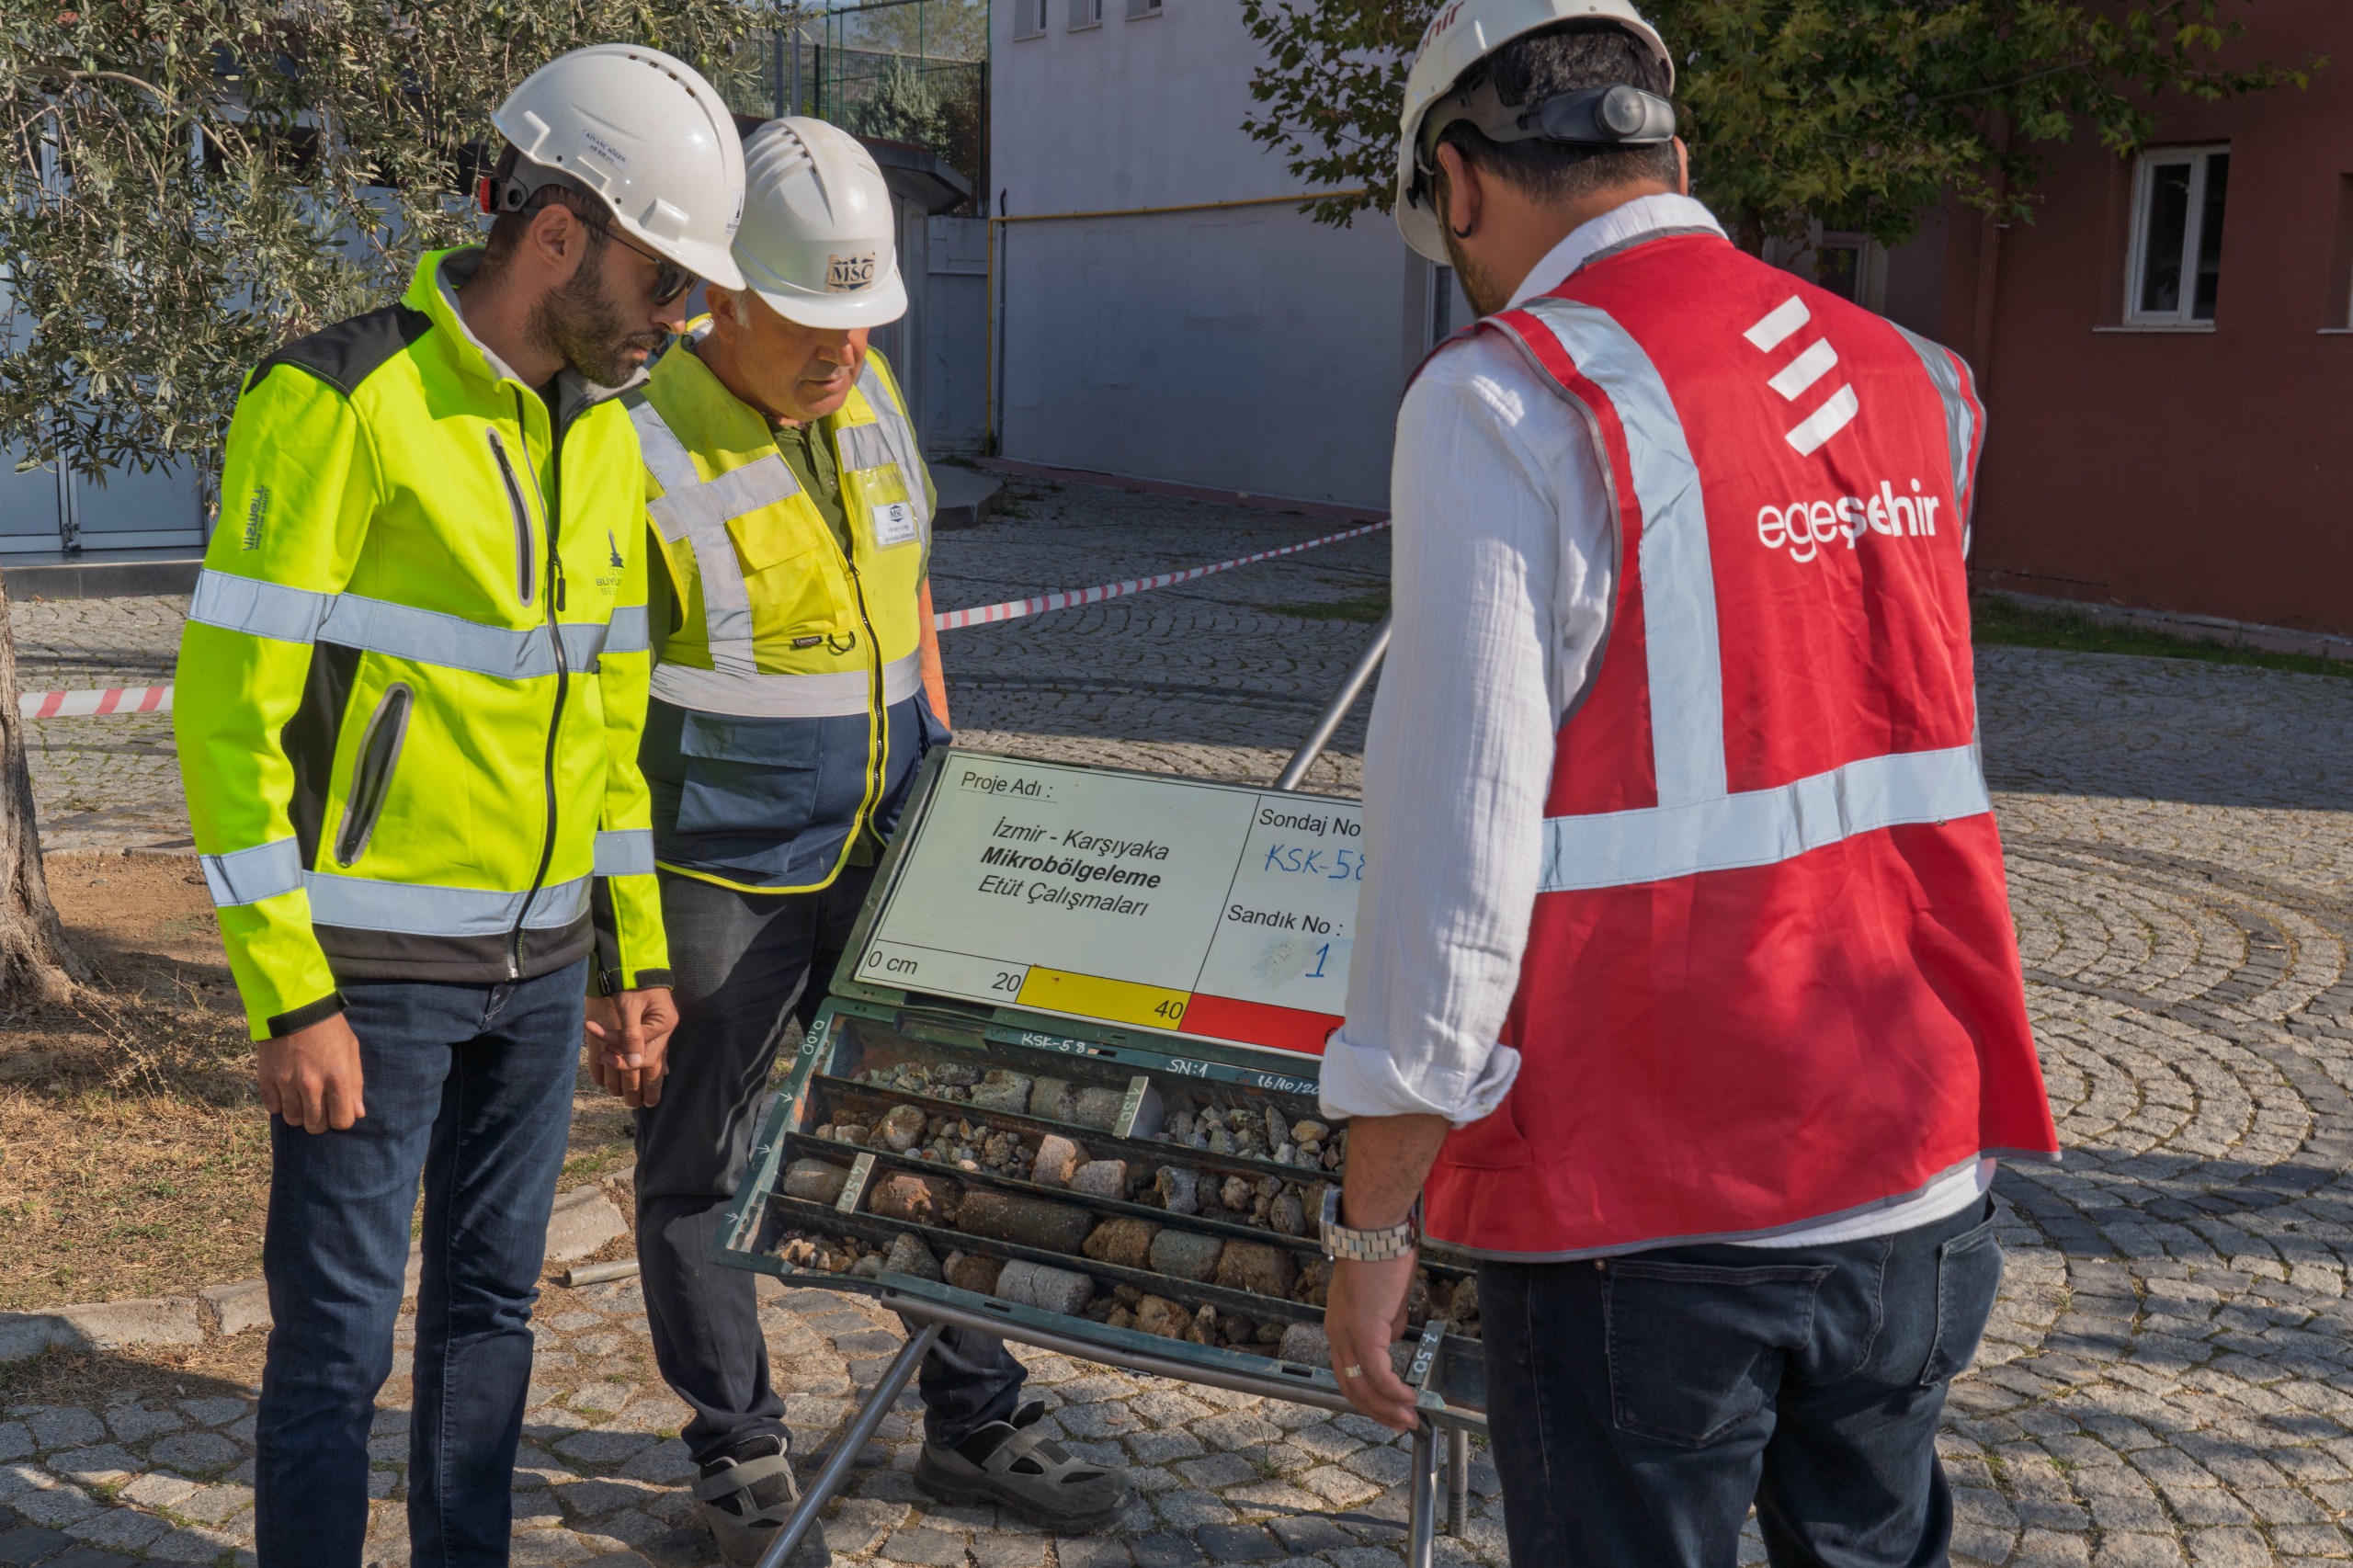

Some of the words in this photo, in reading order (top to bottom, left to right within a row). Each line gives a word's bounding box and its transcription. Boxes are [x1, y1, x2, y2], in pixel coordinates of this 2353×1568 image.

[830, 263, 874, 282] MSC
[889, 508, 904, 519] MSC
[1756, 477, 1940, 563] egeşehir
[961, 770, 1007, 795] Proje
[1009, 778, 1041, 798] Adı
[1046, 786, 1053, 799] :
[1258, 808, 1329, 837] Sondaj
[1332, 817, 1361, 837] No
[992, 815, 1048, 843] İzmir
[1062, 829, 1170, 861] Karşıyaka
[980, 846, 1162, 889] Mikrobölgeleme
[978, 874, 1024, 898] Etüt
[1027, 881, 1149, 917] Çalışmaları
[1227, 903, 1297, 930] Sandık
[1301, 915, 1331, 936] No
[1336, 924, 1344, 937] :
[867, 950, 883, 969] 0
[886, 958, 918, 975] cm
[1304, 942, 1330, 979] 1
[991, 971, 1022, 993] 20
[1154, 999, 1184, 1020] 40
[1165, 1058, 1210, 1079] SN:1
